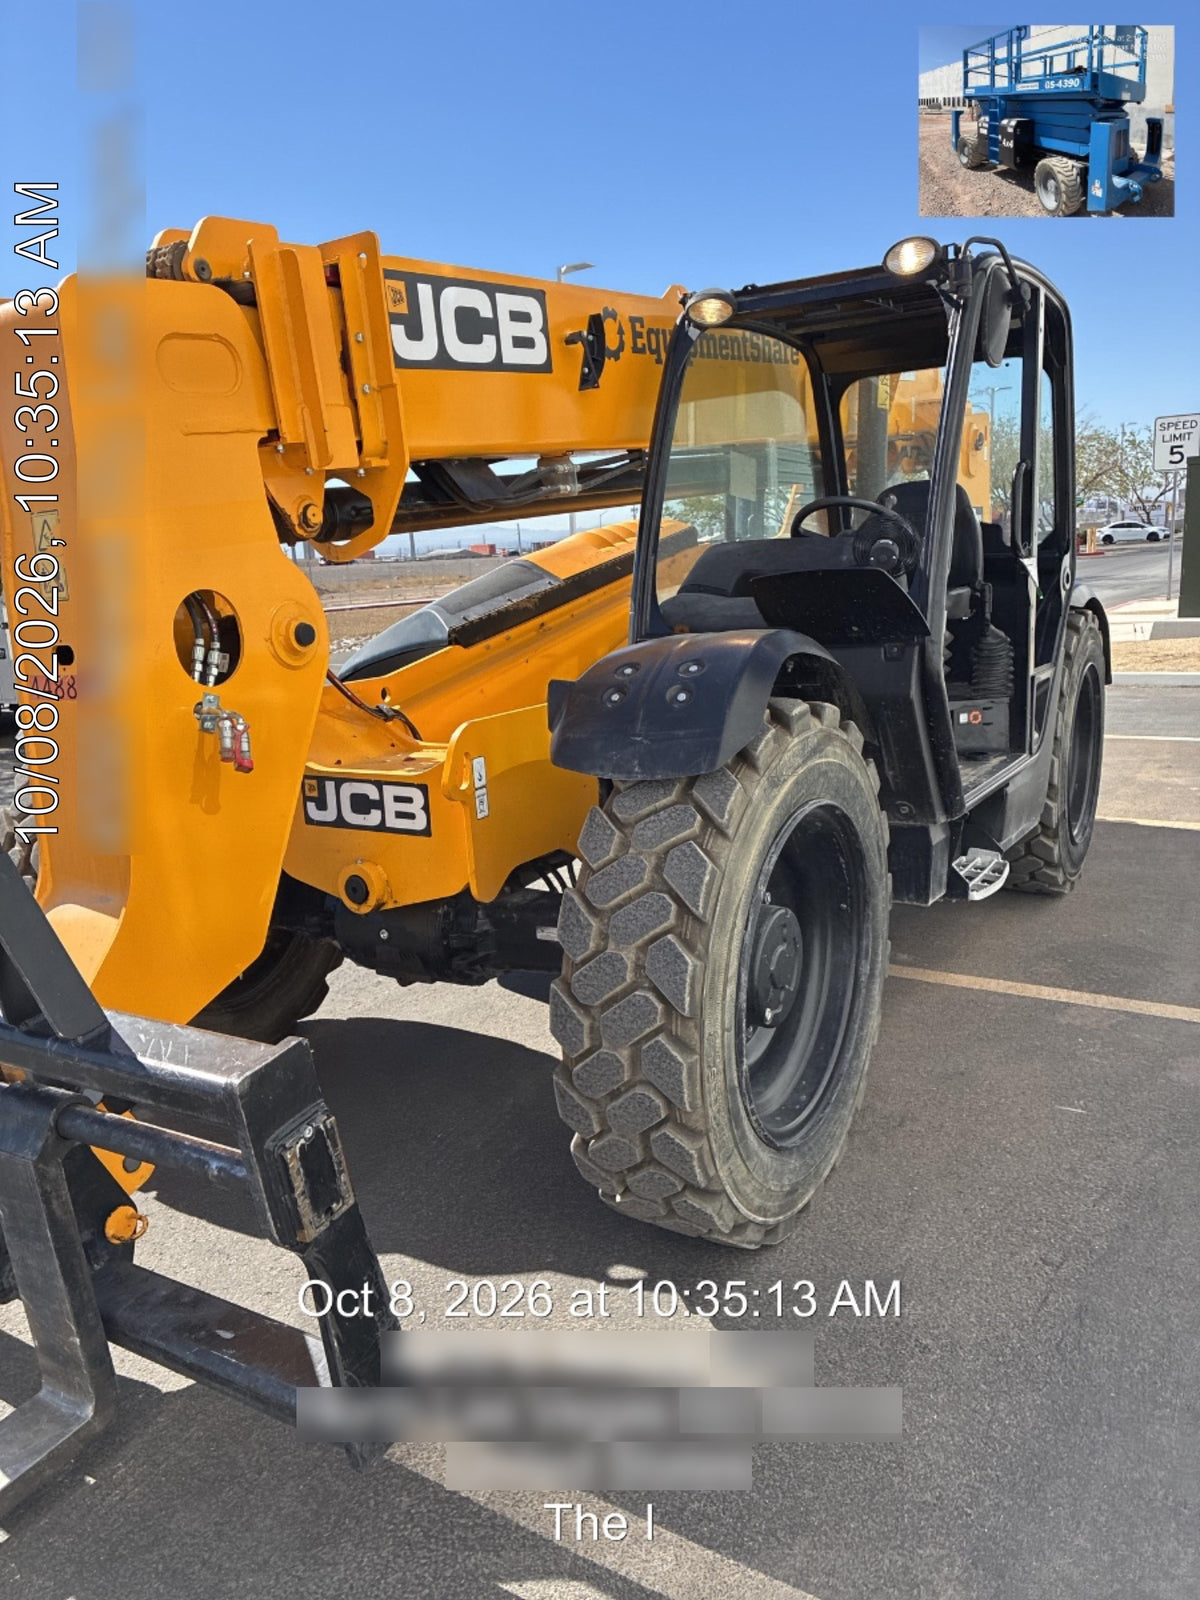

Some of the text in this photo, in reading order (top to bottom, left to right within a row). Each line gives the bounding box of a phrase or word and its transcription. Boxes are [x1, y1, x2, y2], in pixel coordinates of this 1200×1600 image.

[390, 282, 548, 366] JCB
[629, 315, 800, 365] EqumentShare
[1159, 419, 1198, 431] SPEED
[1162, 431, 1194, 443] LIMIT
[1168, 444, 1185, 465] 5
[306, 780, 428, 832] JCB
